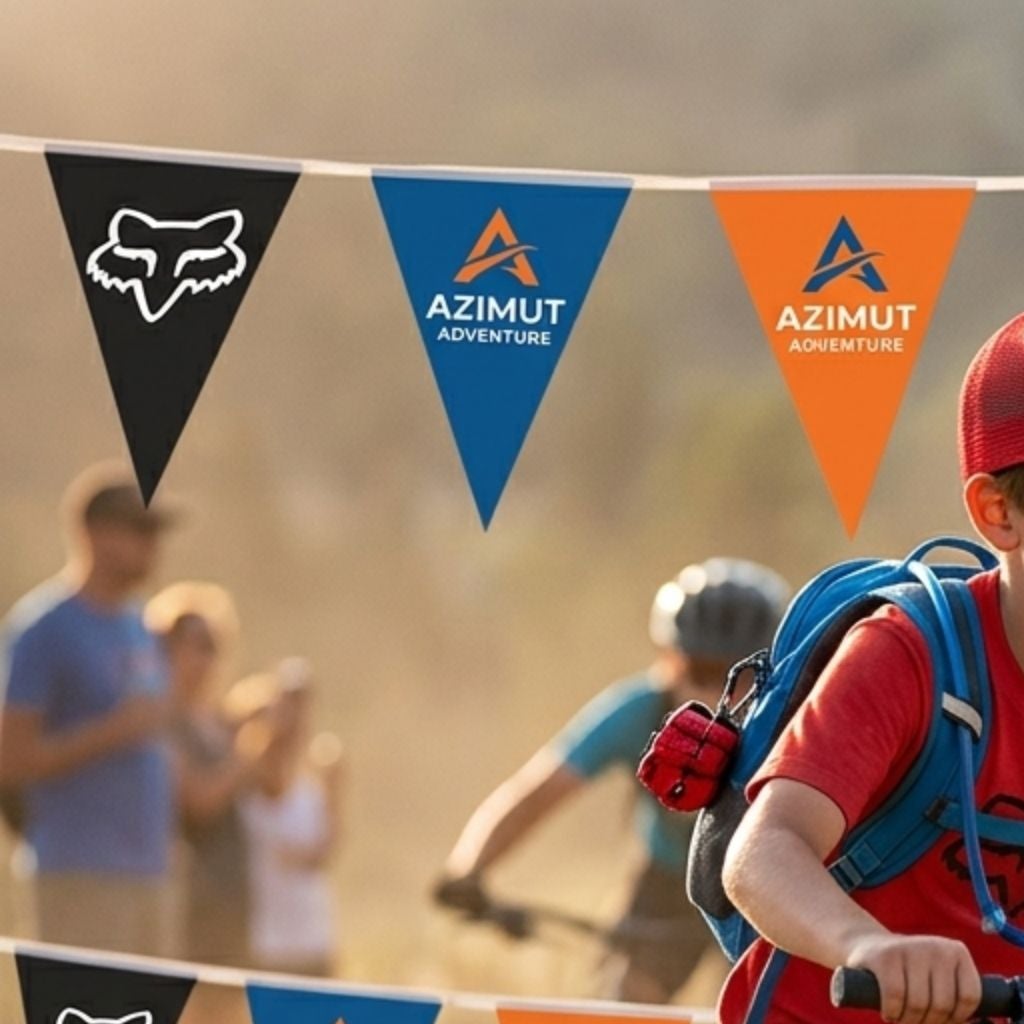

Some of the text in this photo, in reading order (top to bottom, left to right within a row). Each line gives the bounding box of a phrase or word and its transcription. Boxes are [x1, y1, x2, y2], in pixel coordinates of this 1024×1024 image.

[425, 293, 567, 325] AZIMUT
[776, 304, 917, 331] AZIMUT
[437, 326, 552, 346] ADVENTURE
